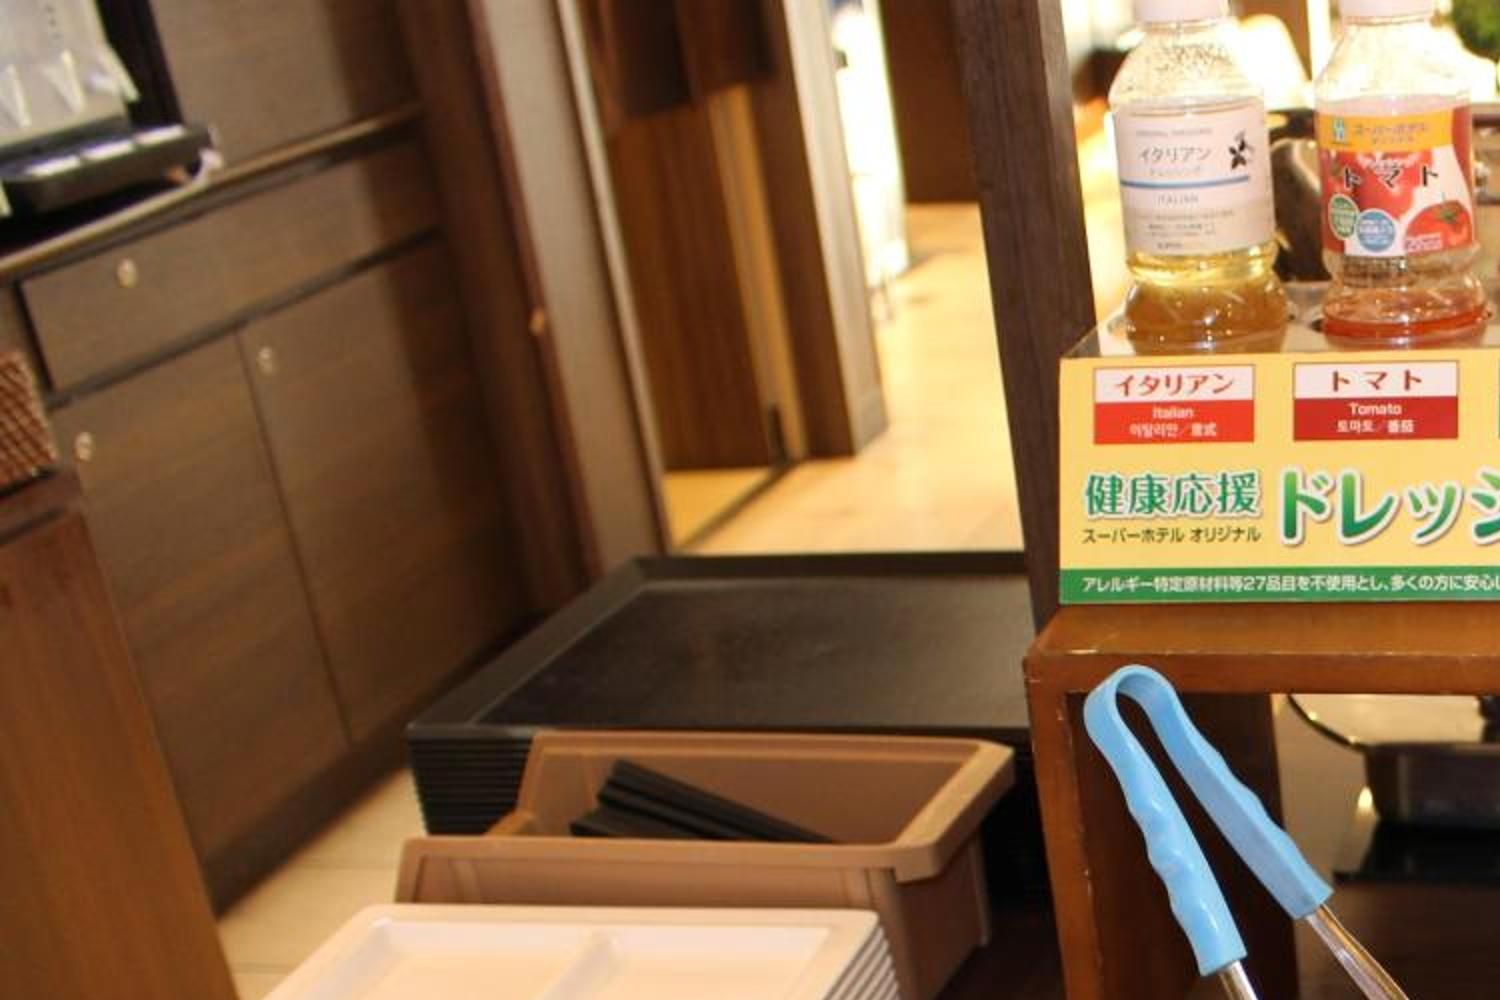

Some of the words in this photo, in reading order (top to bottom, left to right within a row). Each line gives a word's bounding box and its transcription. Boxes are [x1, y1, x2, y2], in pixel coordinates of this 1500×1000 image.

[1138, 145, 1212, 164] イタリアン
[1343, 164, 1440, 189] トマト
[1115, 373, 1236, 398] イタリアン
[1332, 369, 1423, 393] トマト
[1152, 406, 1195, 420] Italian
[1348, 402, 1403, 416] Tomato
[1084, 471, 1261, 518] 健康応援
[1082, 527, 1184, 545] スーパーホテル
[1190, 526, 1262, 543] オリジナル
